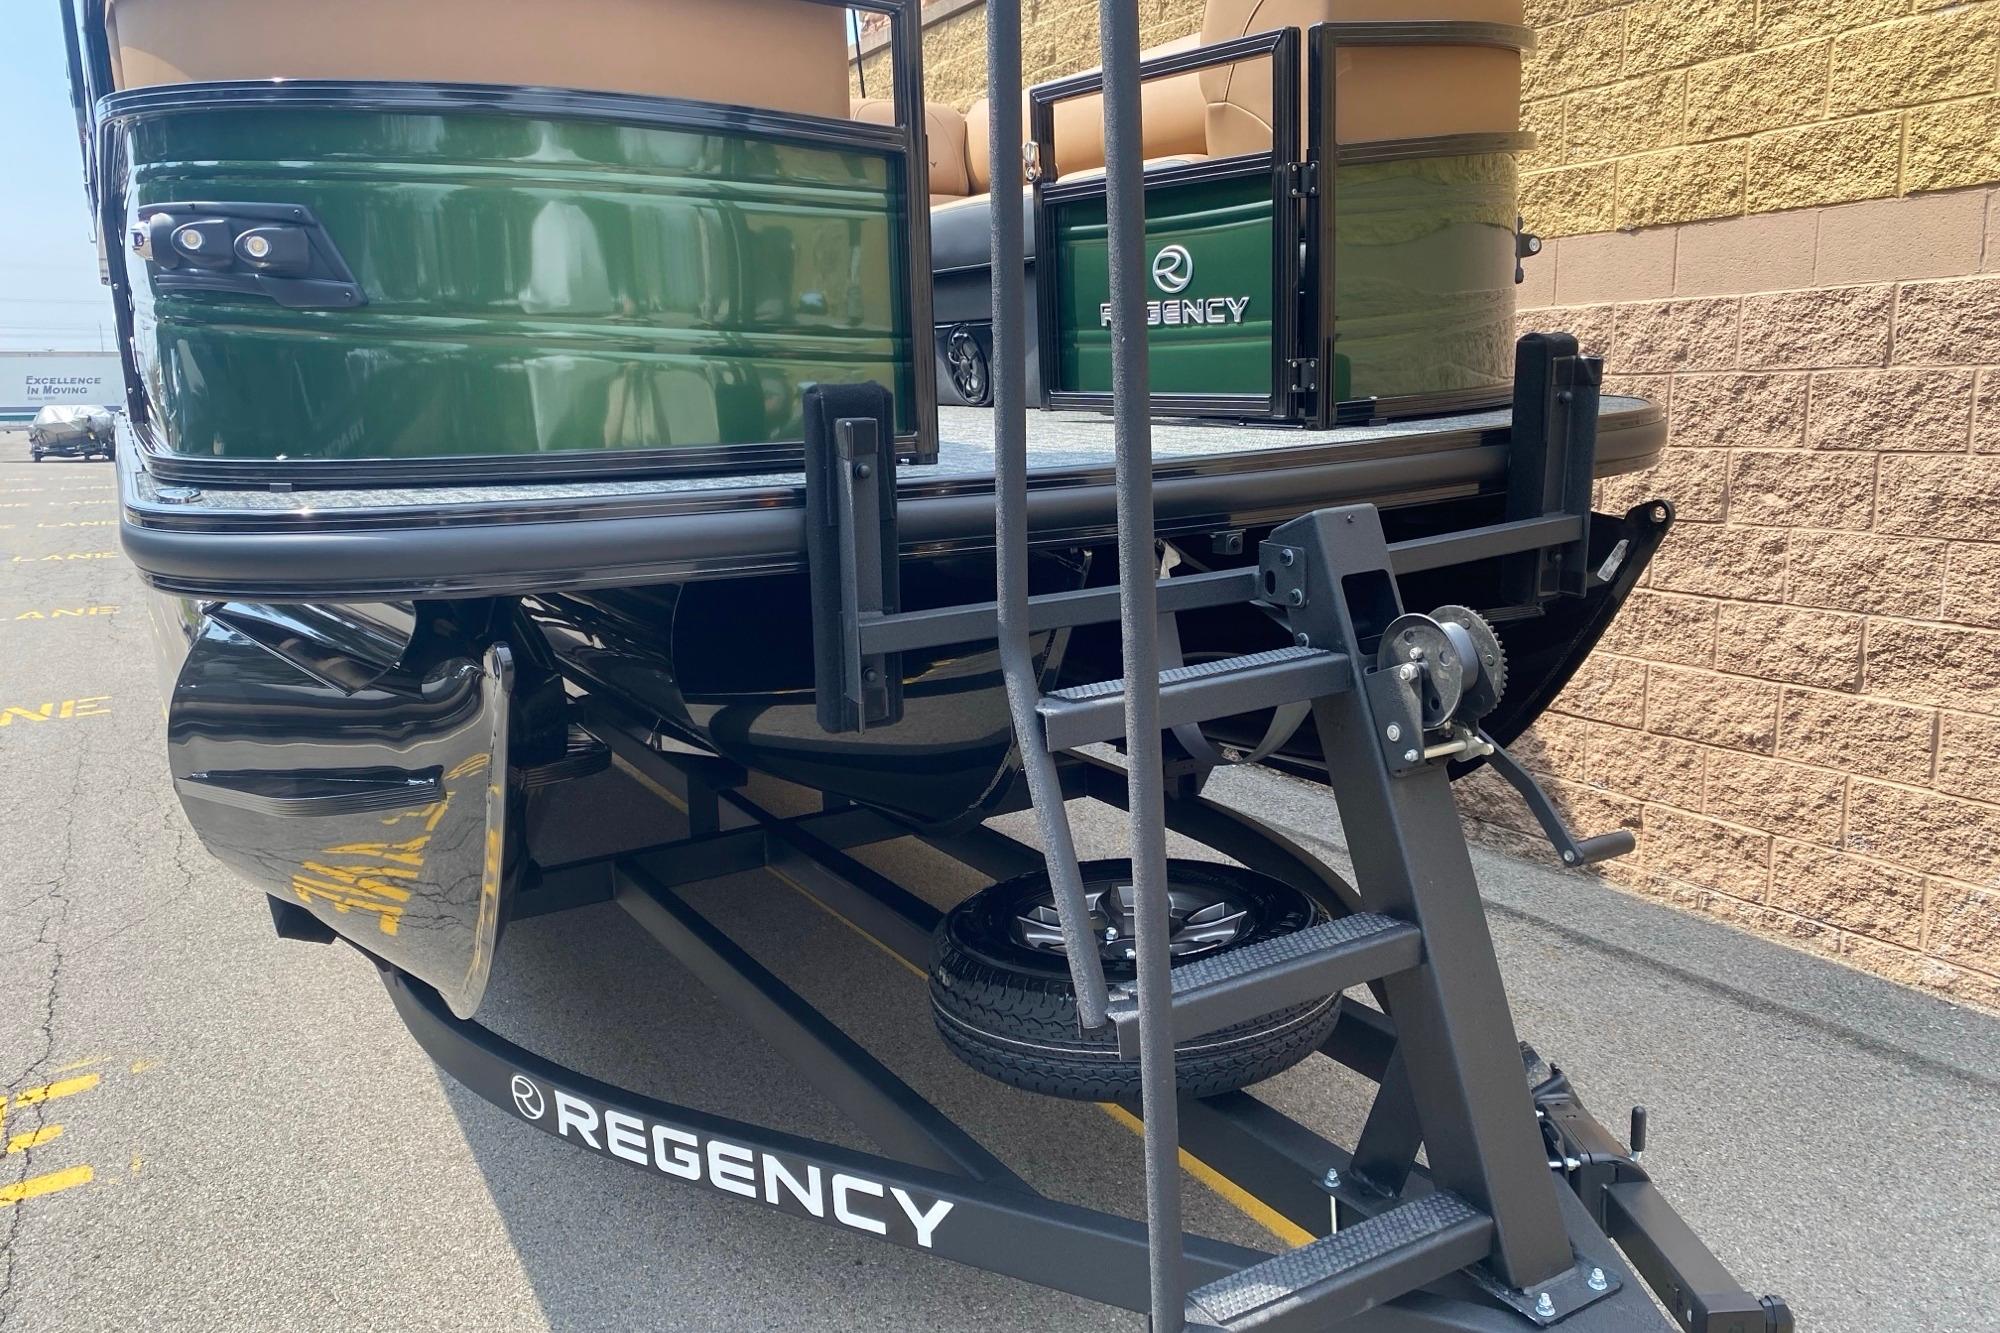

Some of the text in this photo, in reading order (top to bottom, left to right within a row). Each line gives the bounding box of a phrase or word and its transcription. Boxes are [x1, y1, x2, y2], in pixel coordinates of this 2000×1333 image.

[1100, 296, 1250, 327] RGENCY
[25, 375, 102, 385] EXCELLENCE
[27, 385, 88, 395] IN MOVING
[12, 552, 120, 562] LANE
[0, 605, 120, 621] ANE
[0, 696, 112, 727] NE
[554, 1089, 954, 1248] REGENCY
